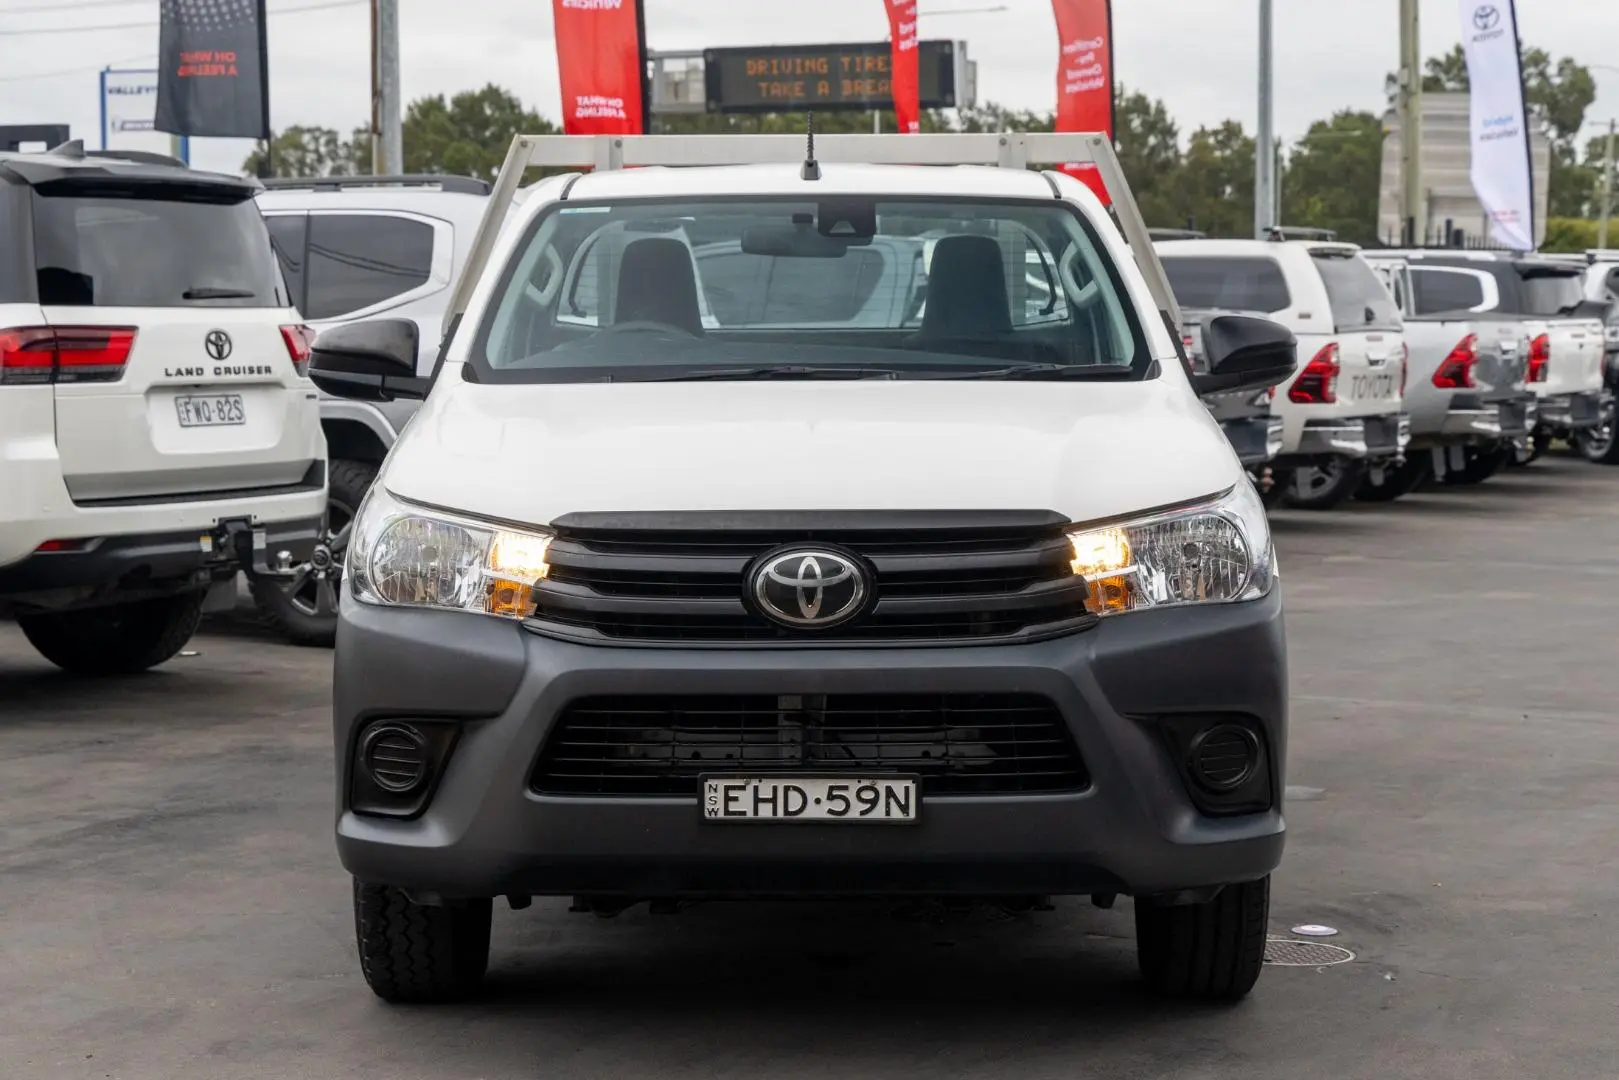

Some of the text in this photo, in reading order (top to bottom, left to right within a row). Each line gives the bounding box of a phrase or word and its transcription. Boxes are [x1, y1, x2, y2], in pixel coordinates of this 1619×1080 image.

[746, 56, 890, 75] DRIVING TIRE
[759, 79, 893, 97] TAKE A BREA
[164, 365, 272, 377] LAND CRUISER
[1350, 374, 1393, 399] TOYOTA
